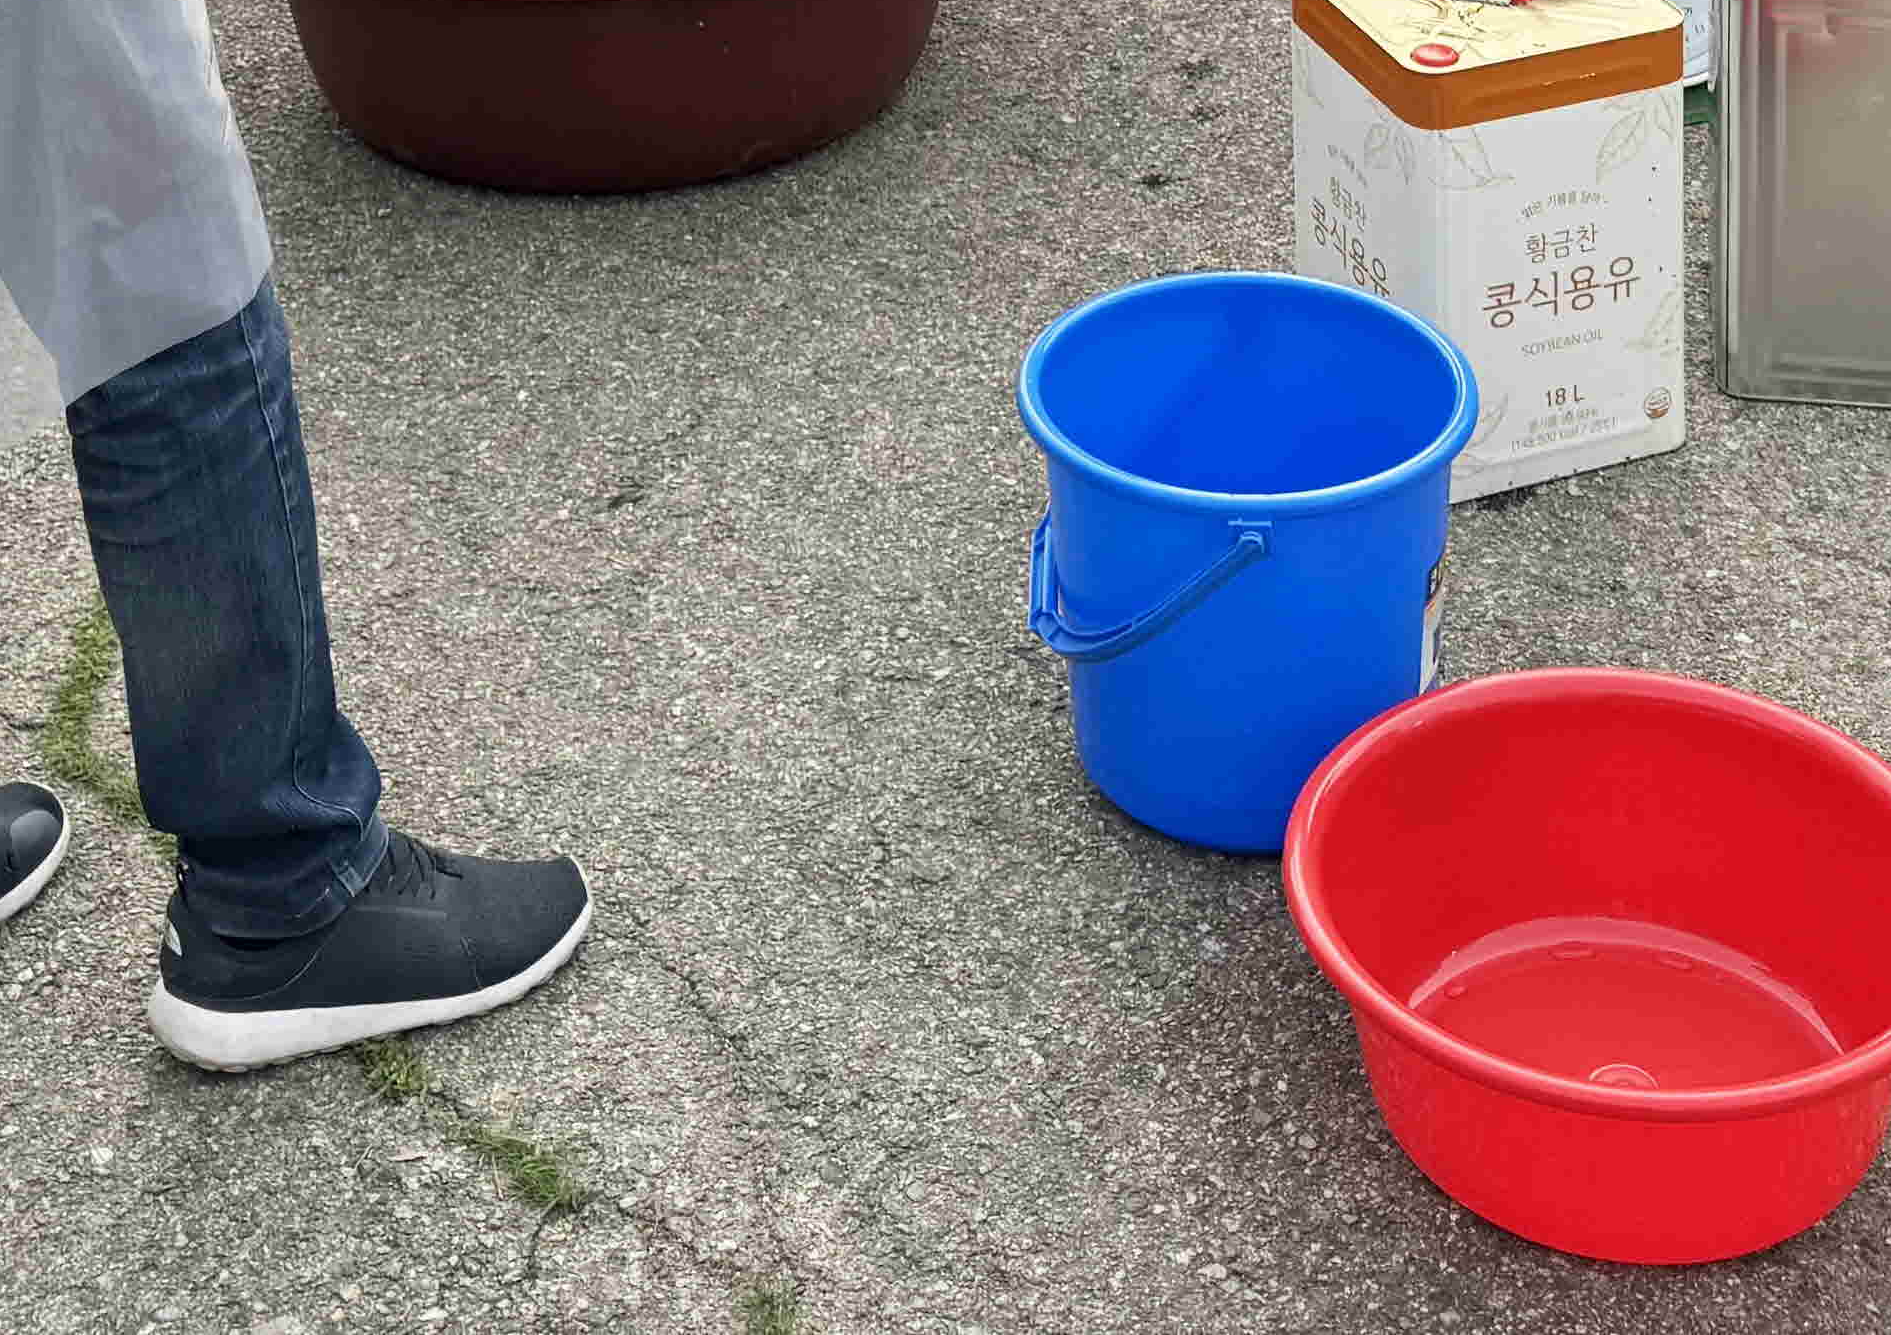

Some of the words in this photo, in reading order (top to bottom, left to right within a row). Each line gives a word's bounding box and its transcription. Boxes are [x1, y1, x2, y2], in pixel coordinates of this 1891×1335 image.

[1524, 223, 1599, 264] 황금찬
[1481, 256, 1643, 329] 콩식용유
[1546, 386, 1567, 407] 18
